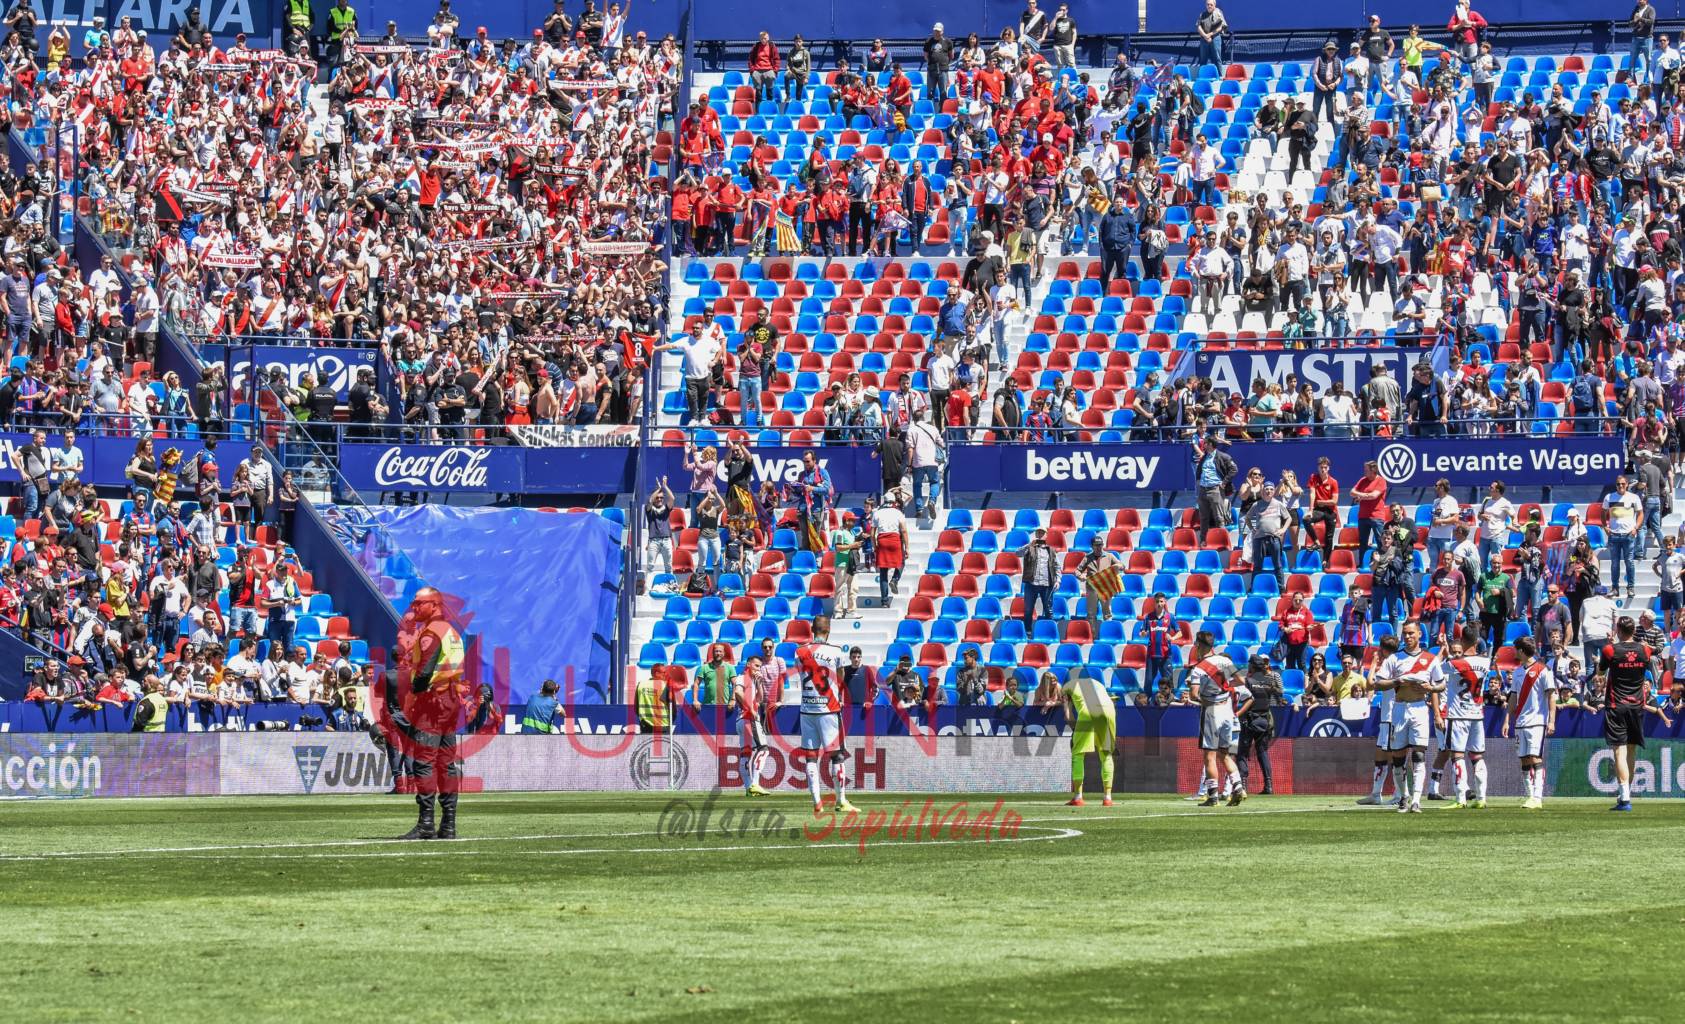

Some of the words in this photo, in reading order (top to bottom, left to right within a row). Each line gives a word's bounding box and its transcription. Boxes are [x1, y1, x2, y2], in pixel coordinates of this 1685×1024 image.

[374, 446, 492, 489] Coca-Cola
[1026, 449, 1160, 488] betway
[1422, 449, 1523, 472] Levante
[1530, 449, 1621, 475] Wagen
[718, 746, 886, 790] BOSCH
